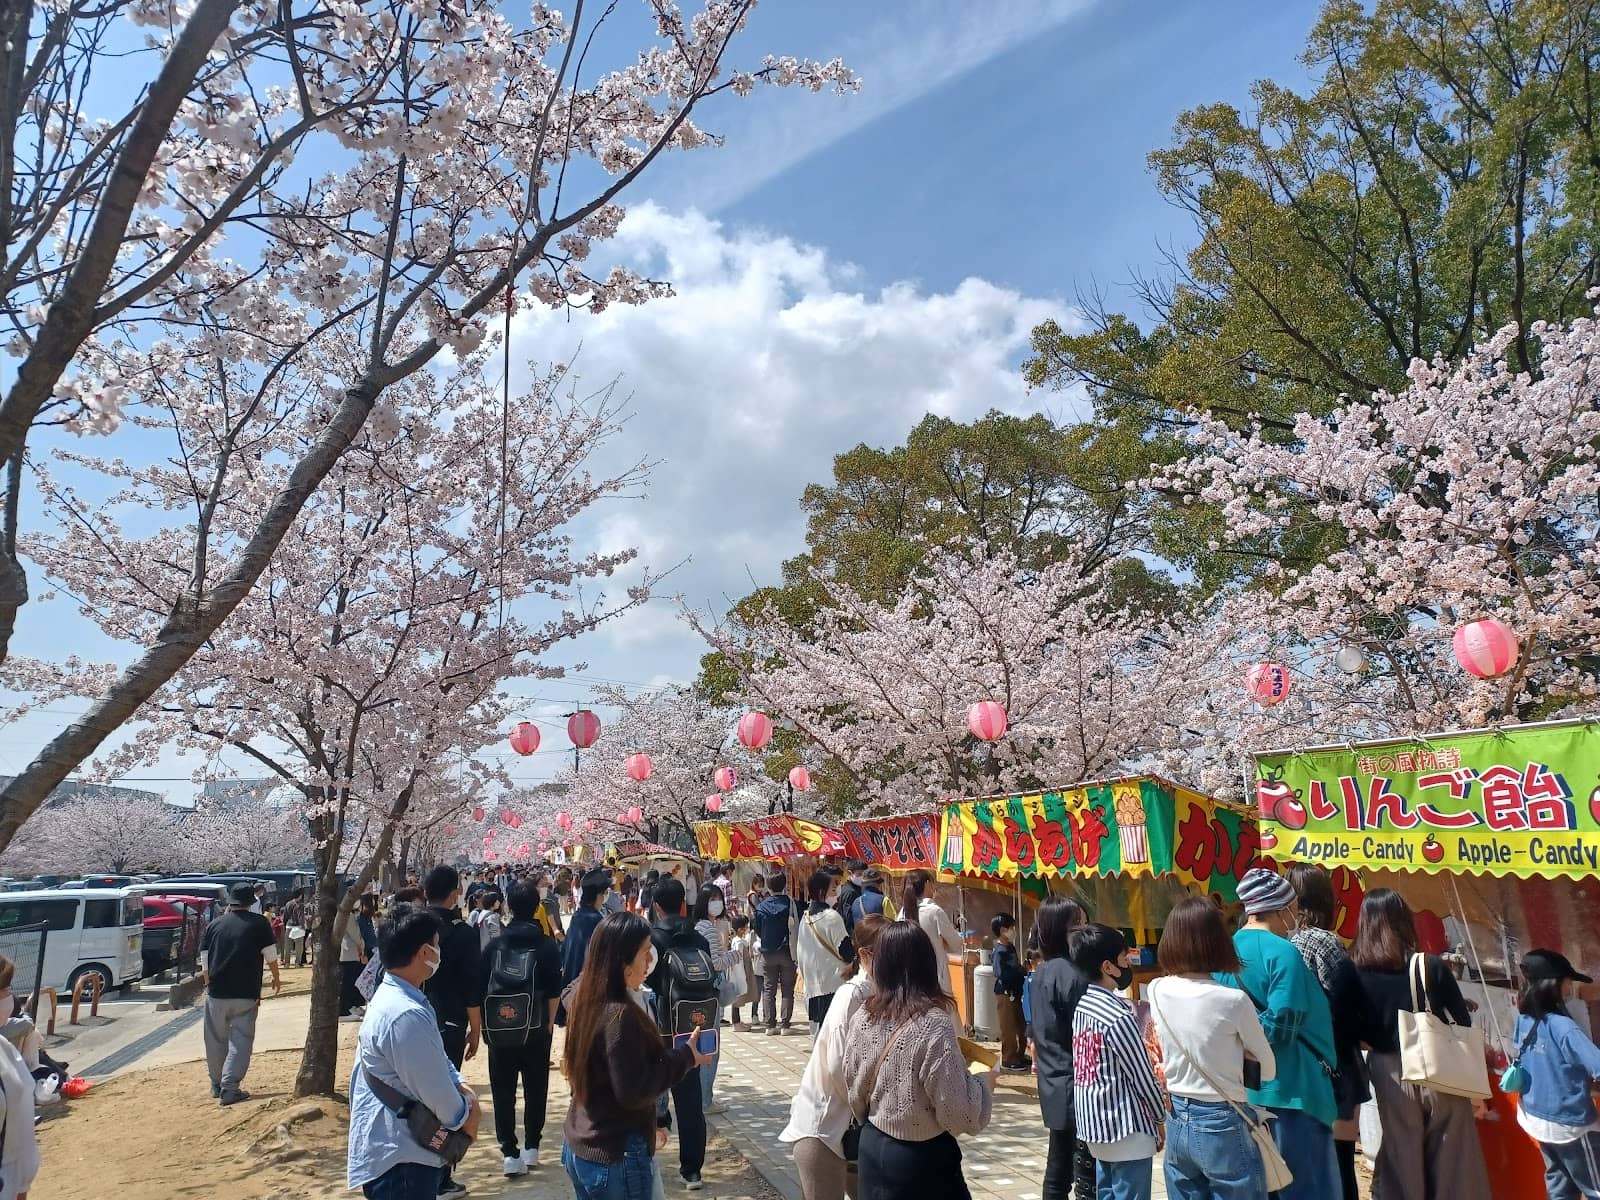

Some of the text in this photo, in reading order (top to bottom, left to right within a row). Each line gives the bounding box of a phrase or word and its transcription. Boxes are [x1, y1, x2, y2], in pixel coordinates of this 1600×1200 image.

[1360, 747, 1461, 776] 街の風物詩
[1309, 760, 1577, 831] りんご飴
[972, 804, 1110, 868] からあげ
[1291, 837, 1414, 863] Apple-Candy
[1458, 837, 1598, 869] Apple-Candy
